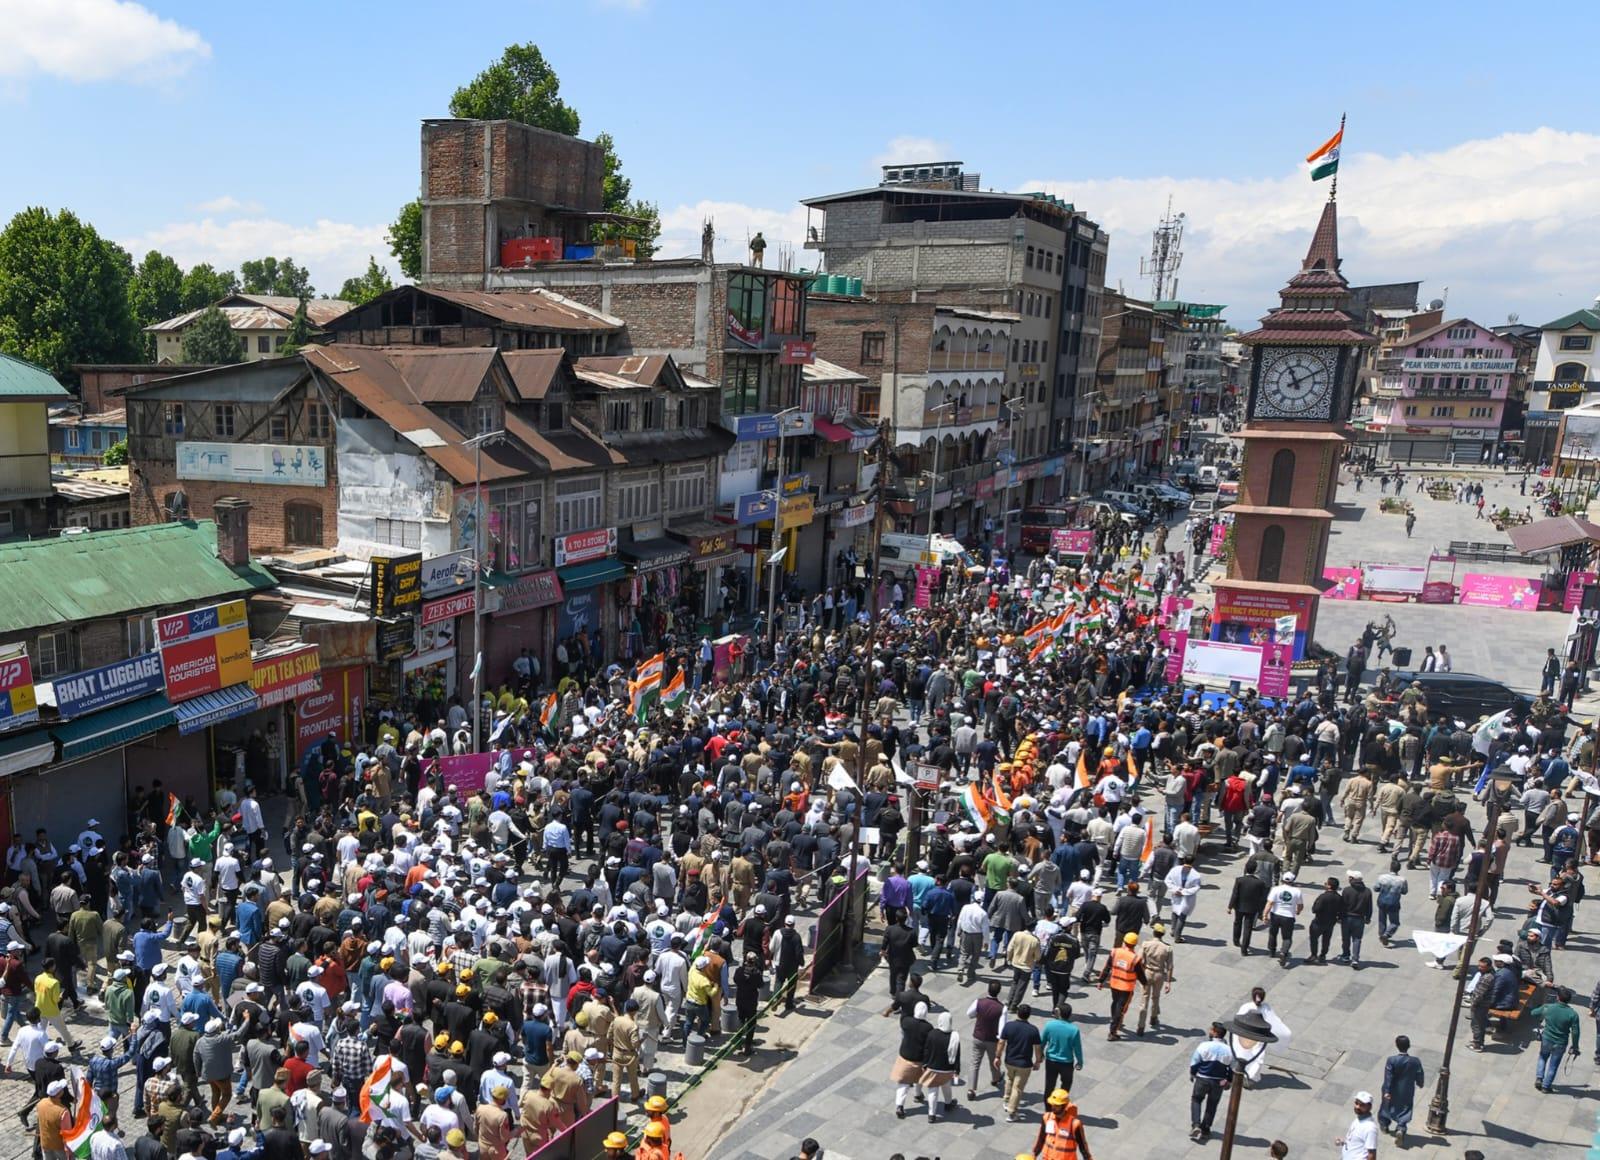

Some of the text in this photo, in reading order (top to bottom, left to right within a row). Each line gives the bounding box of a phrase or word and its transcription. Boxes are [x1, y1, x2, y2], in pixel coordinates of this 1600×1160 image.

[1405, 361, 1420, 369] PEAK
[1423, 361, 1439, 369] VIEW
[1441, 361, 1462, 369] HOTEL
[1470, 362, 1514, 370] RESTAURANT
[587, 535, 606, 546] STORE
[395, 560, 421, 575] NISHAT
[399, 576, 416, 590] DRY
[393, 590, 420, 607] FRUITS
[428, 595, 476, 619] ZEE SPORTS
[1220, 606, 1247, 615] DISTRICT
[1248, 608, 1269, 617] POLICE
[163, 620, 184, 637] VIP
[168, 654, 216, 675] AMERICAN
[168, 663, 217, 684] TOURISTER
[278, 660, 296, 681] TEA
[295, 651, 321, 676] STALL
[0, 661, 22, 688] IP
[56, 674, 96, 705] BHAT
[98, 656, 161, 691] LUGGAGE
[300, 715, 342, 738] FRONTLINE
